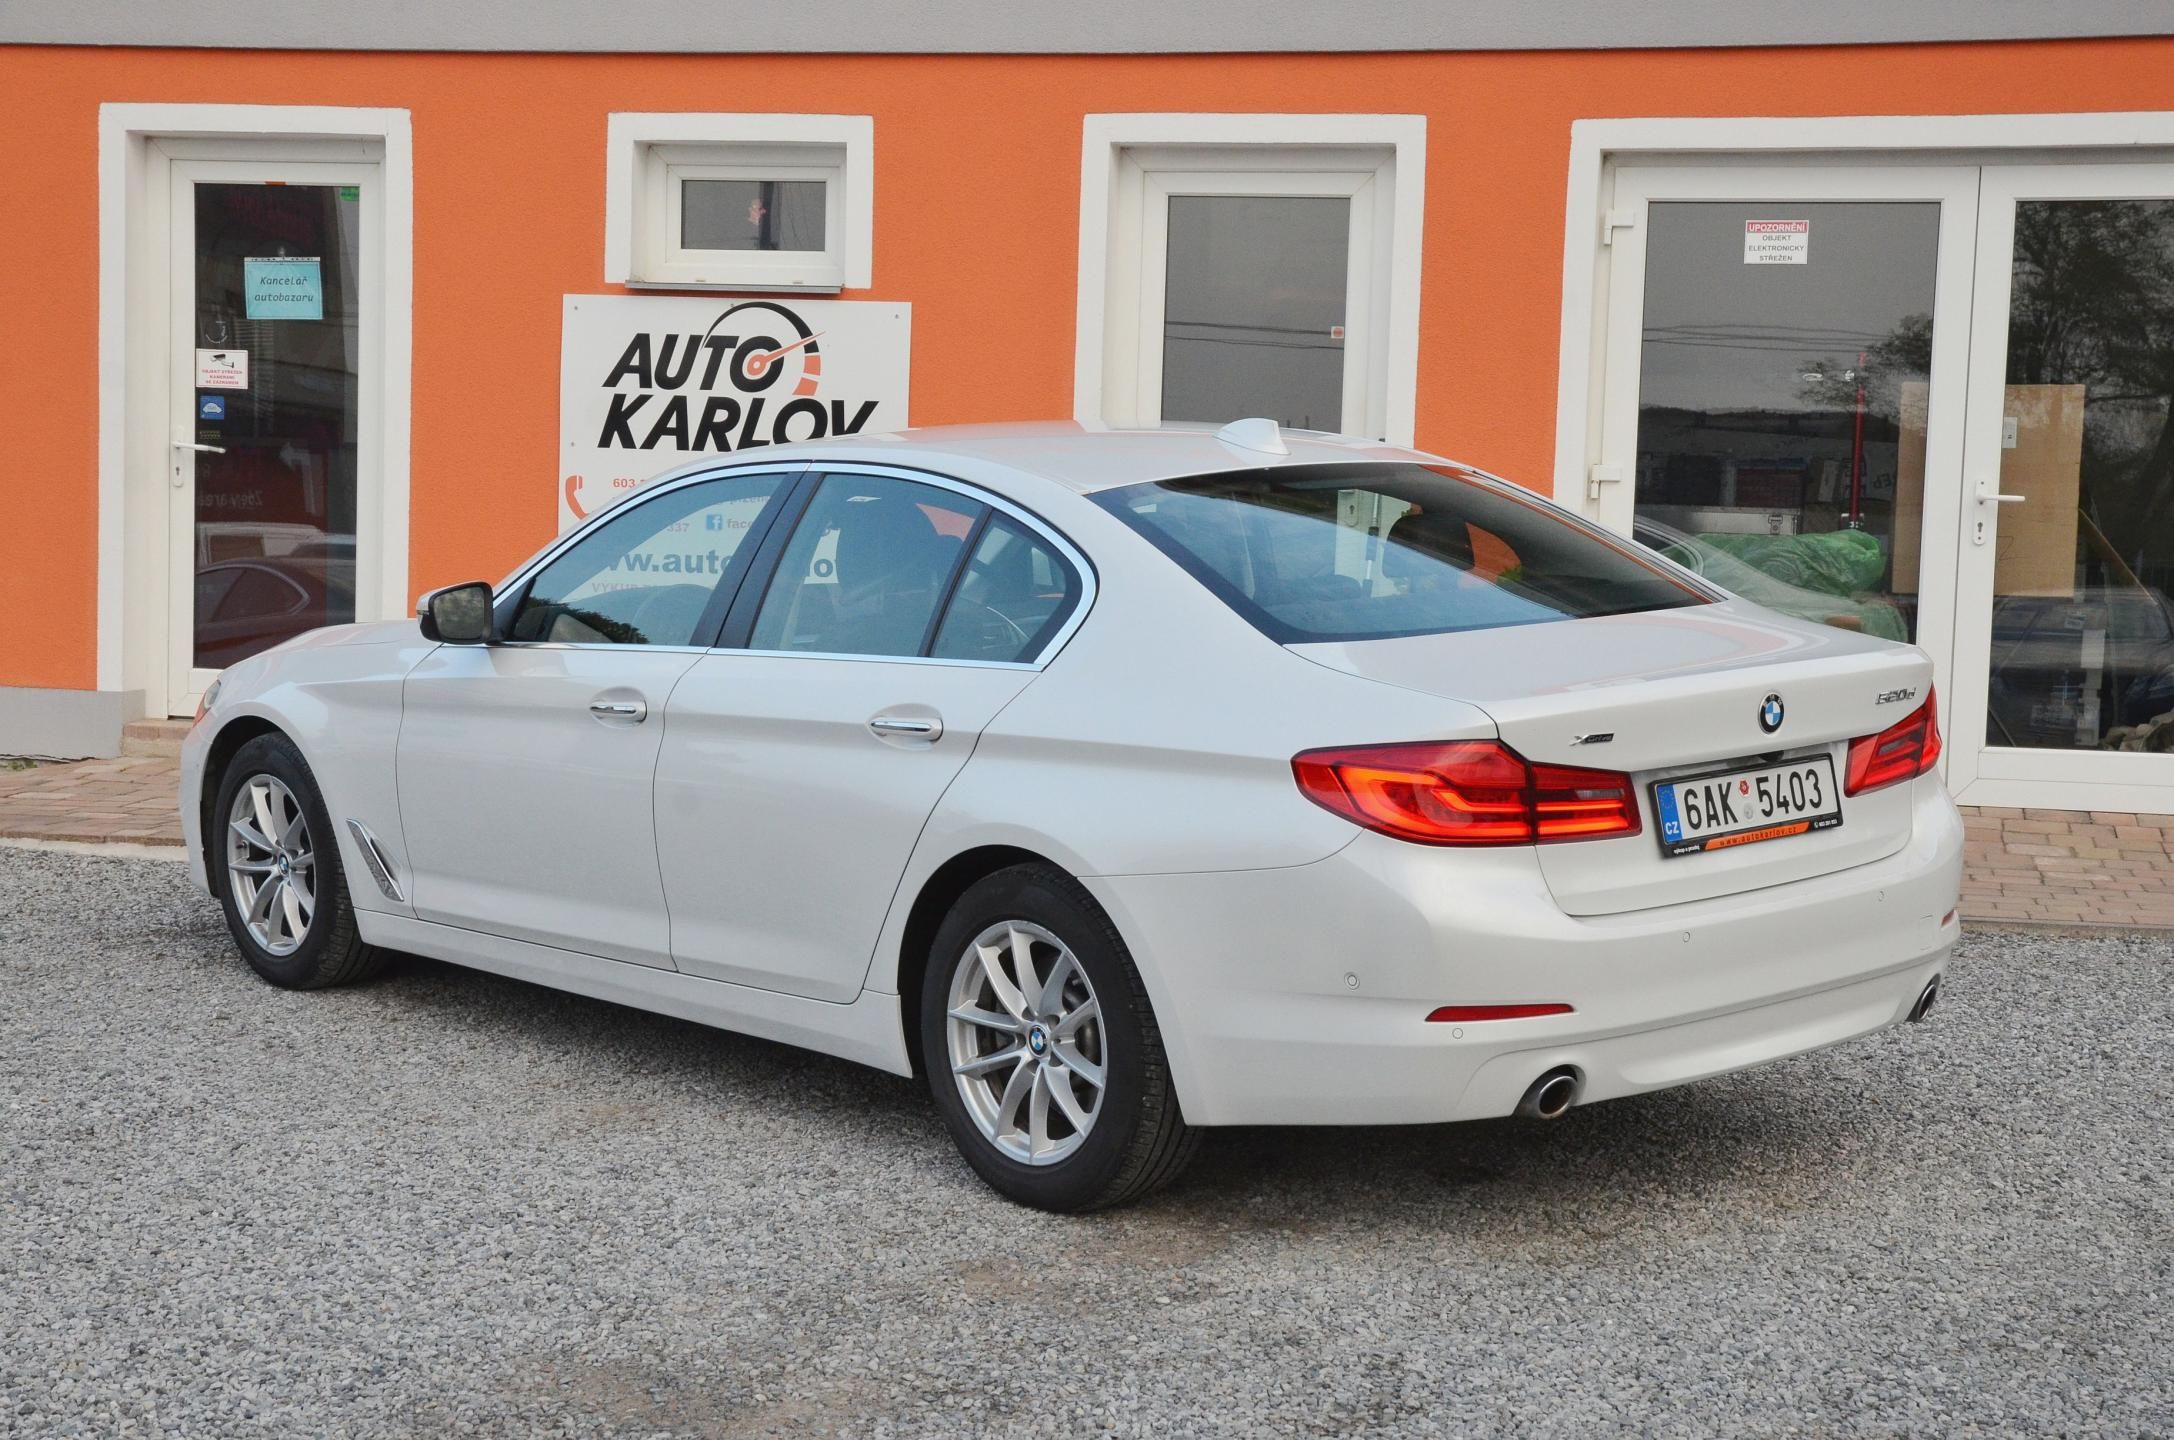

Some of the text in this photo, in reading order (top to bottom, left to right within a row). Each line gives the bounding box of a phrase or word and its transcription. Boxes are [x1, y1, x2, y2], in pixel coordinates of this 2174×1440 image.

[1749, 223, 1805, 232] UPOZORNĚNÍ
[260, 276, 308, 286] Kancelář
[254, 294, 314, 302] autobazaru
[602, 333, 784, 393] AUTO
[597, 393, 880, 453] KARLOV
[613, 478, 636, 488] 603
[1875, 688, 1916, 705] 520d
[1684, 769, 1822, 830] 6AK 5403
[1665, 820, 1680, 834] CZ
[1720, 826, 1797, 846] www.autokarlov.cz
